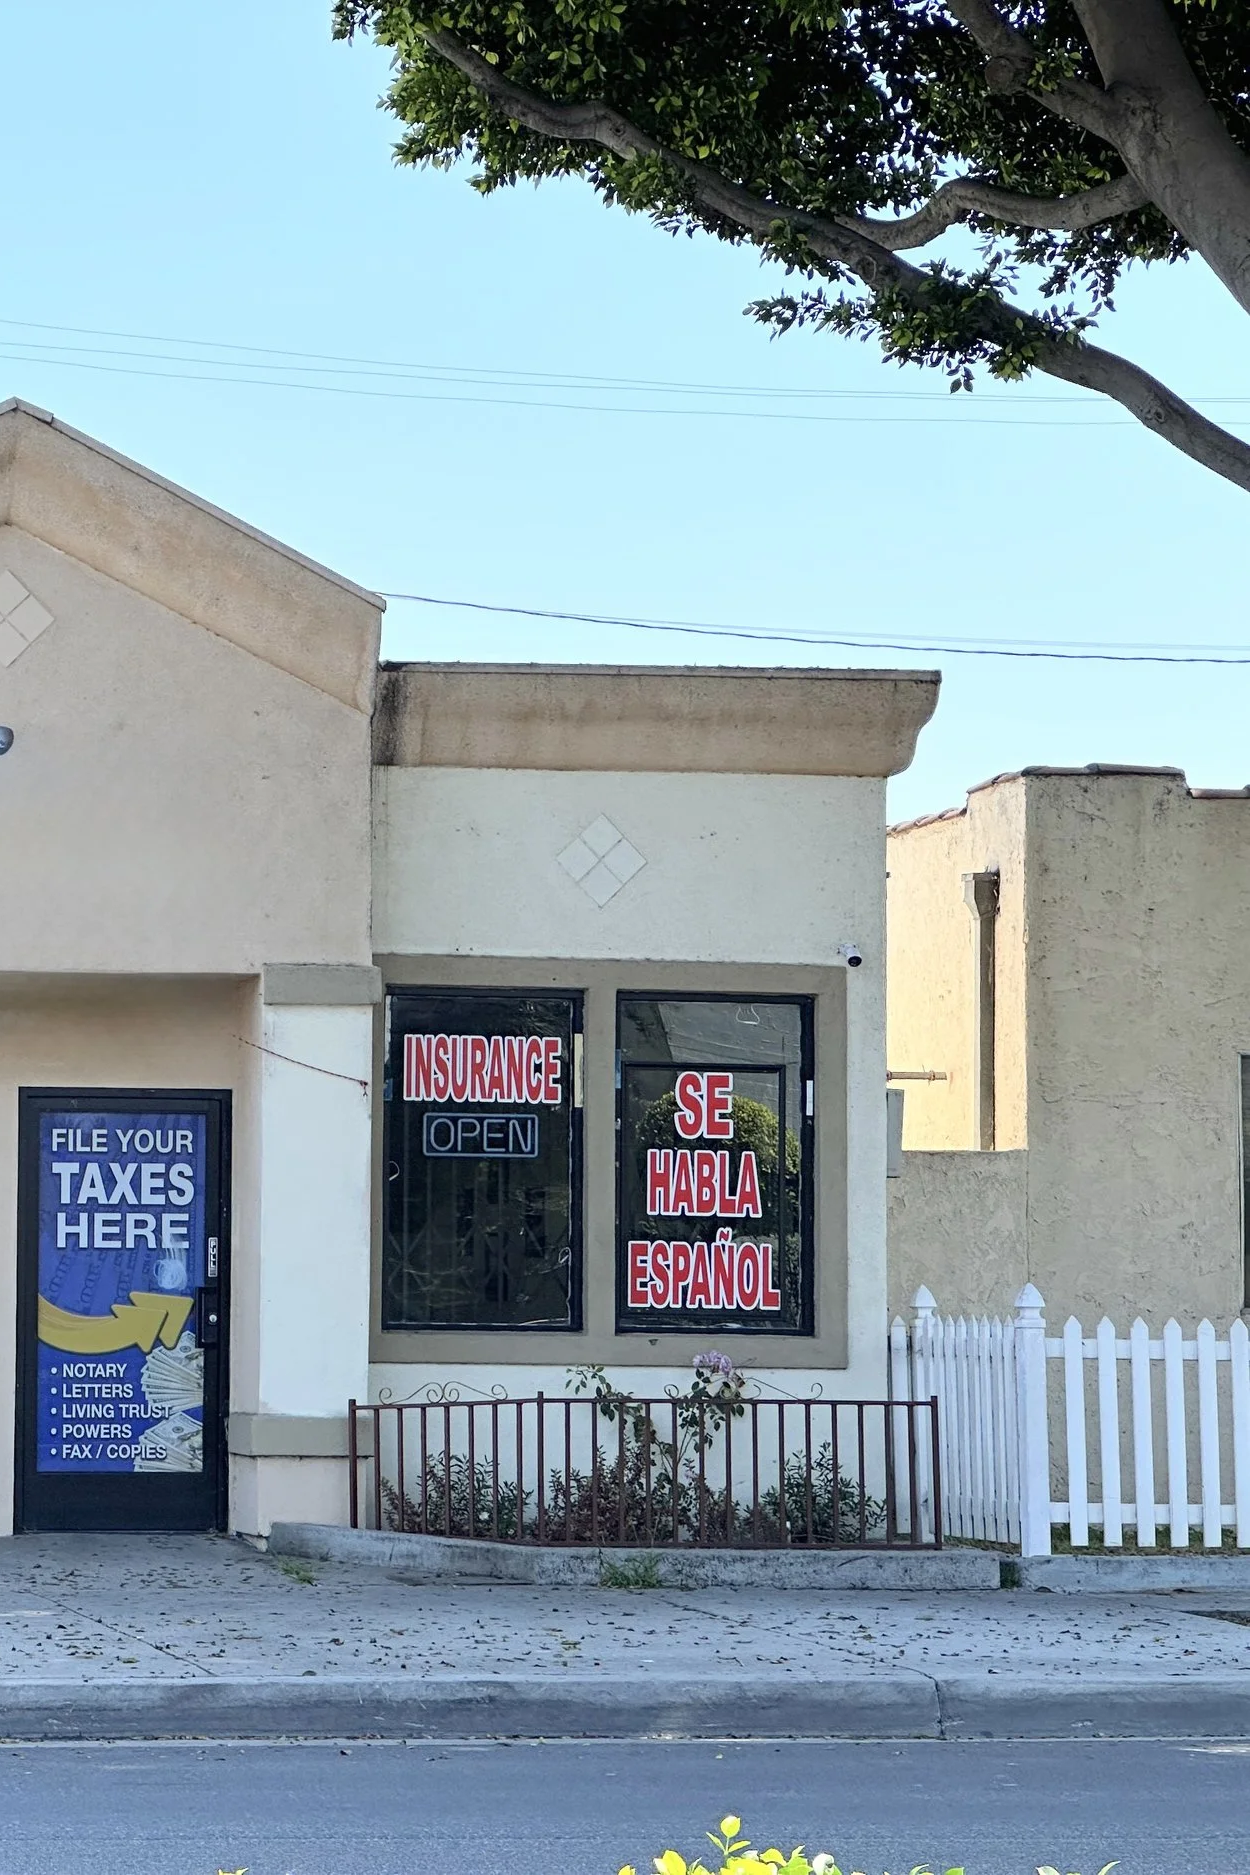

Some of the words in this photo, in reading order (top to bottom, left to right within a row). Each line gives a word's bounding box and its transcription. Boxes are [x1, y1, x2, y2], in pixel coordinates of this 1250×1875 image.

[403, 1034, 562, 1104] INSURANCE
[673, 1071, 734, 1139] SE
[51, 1128, 108, 1152] FILE
[115, 1129, 194, 1153] YOUR
[430, 1118, 532, 1153] OPEN
[52, 1162, 195, 1206] TAXES
[647, 1149, 762, 1218] HABLA
[56, 1212, 190, 1249] HERE
[628, 1227, 781, 1311] ESPAÑOL
[62, 1363, 128, 1378] NOTARY
[62, 1383, 134, 1398] LETTERS
[62, 1403, 115, 1419] LIVING
[118, 1404, 172, 1419] TRUST
[62, 1423, 132, 1439] POWERS
[62, 1444, 92, 1459] FAX
[106, 1444, 167, 1459] COPIES
